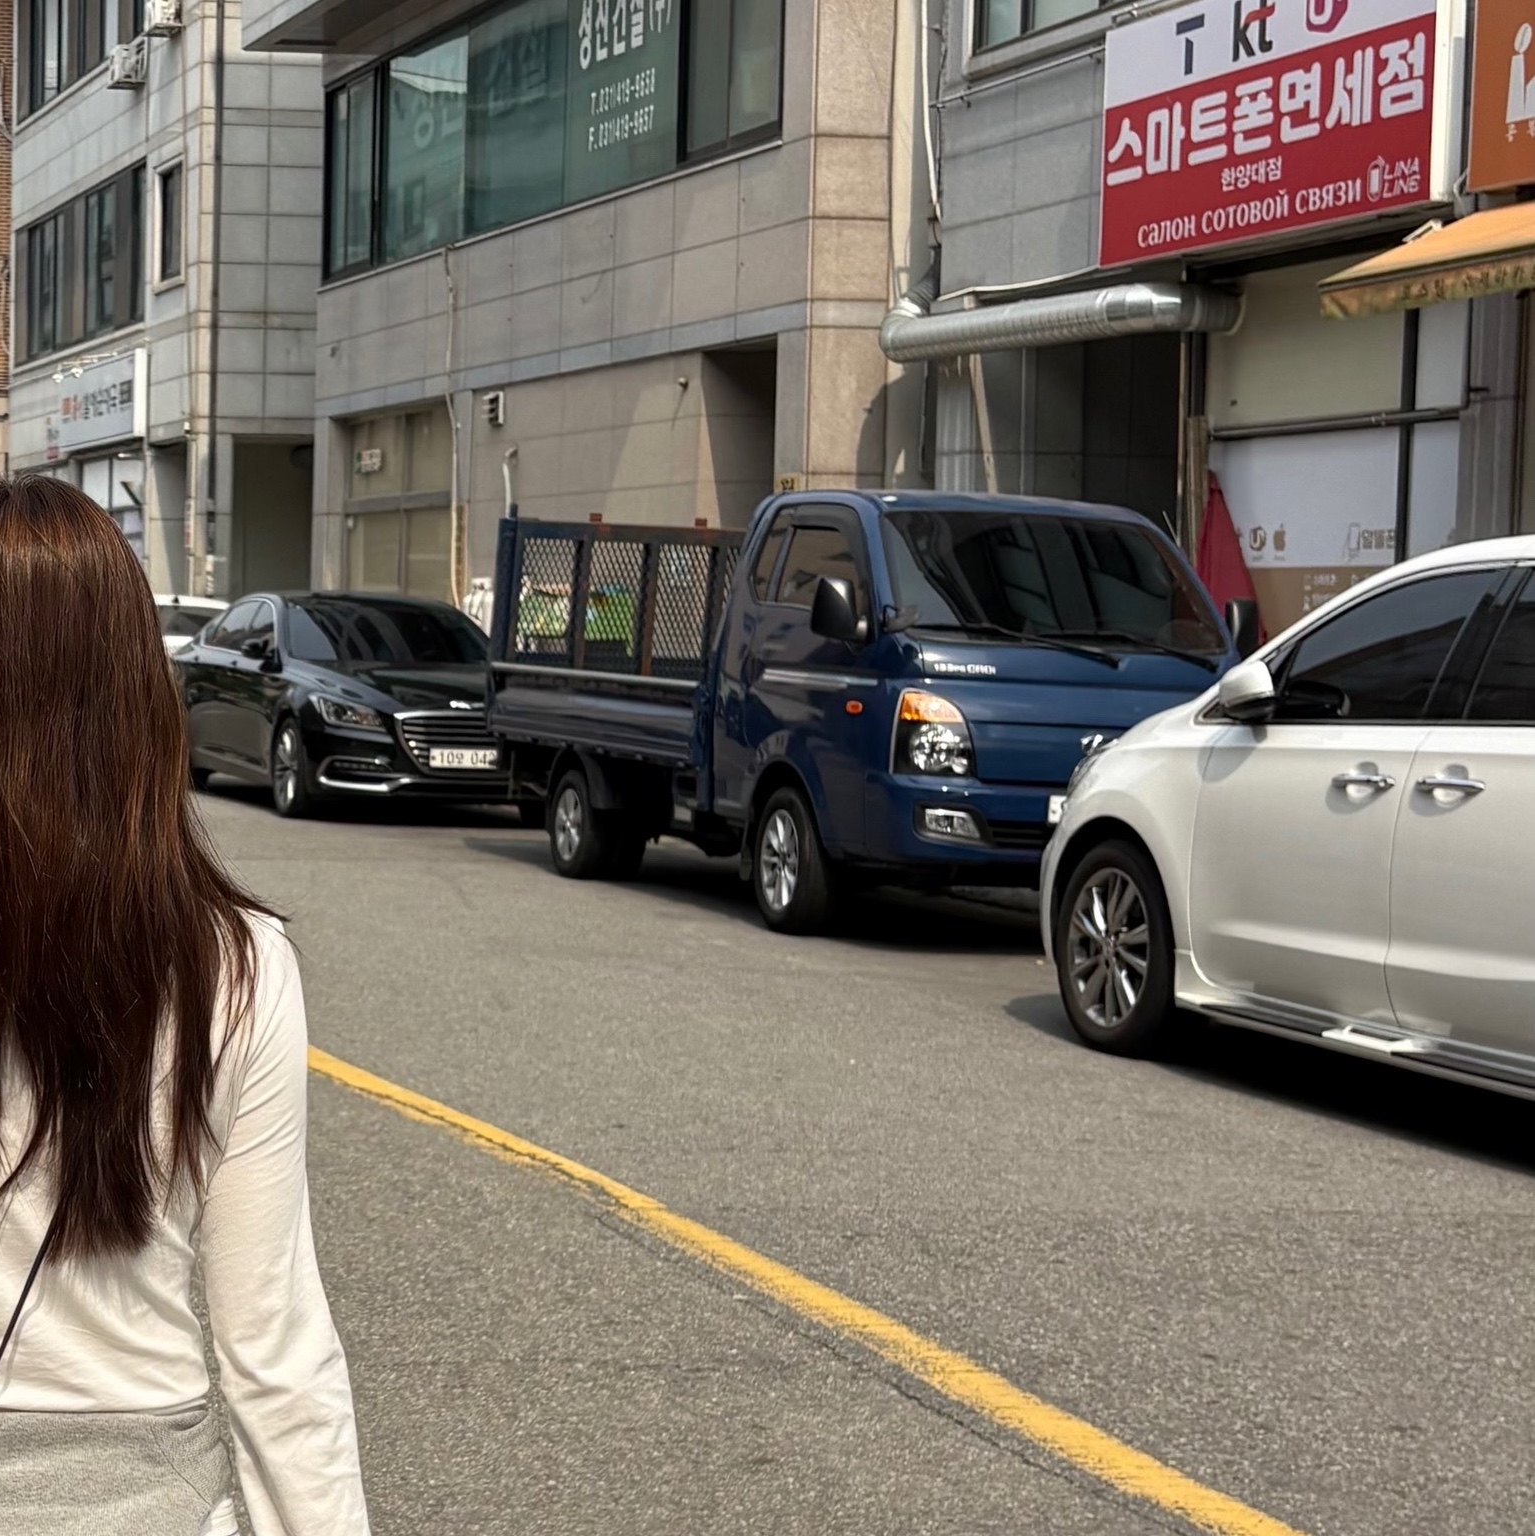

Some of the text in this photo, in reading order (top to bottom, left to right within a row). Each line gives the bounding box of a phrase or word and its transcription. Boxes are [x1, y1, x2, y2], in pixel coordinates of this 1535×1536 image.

[1176, 14, 1205, 75] T
[1232, 0, 1276, 62] kt
[1107, 32, 1425, 186] 스마트폰면세점
[1221, 156, 1282, 191] 한양대점
[1383, 157, 1420, 180] LINA
[1383, 175, 1421, 198] LINE
